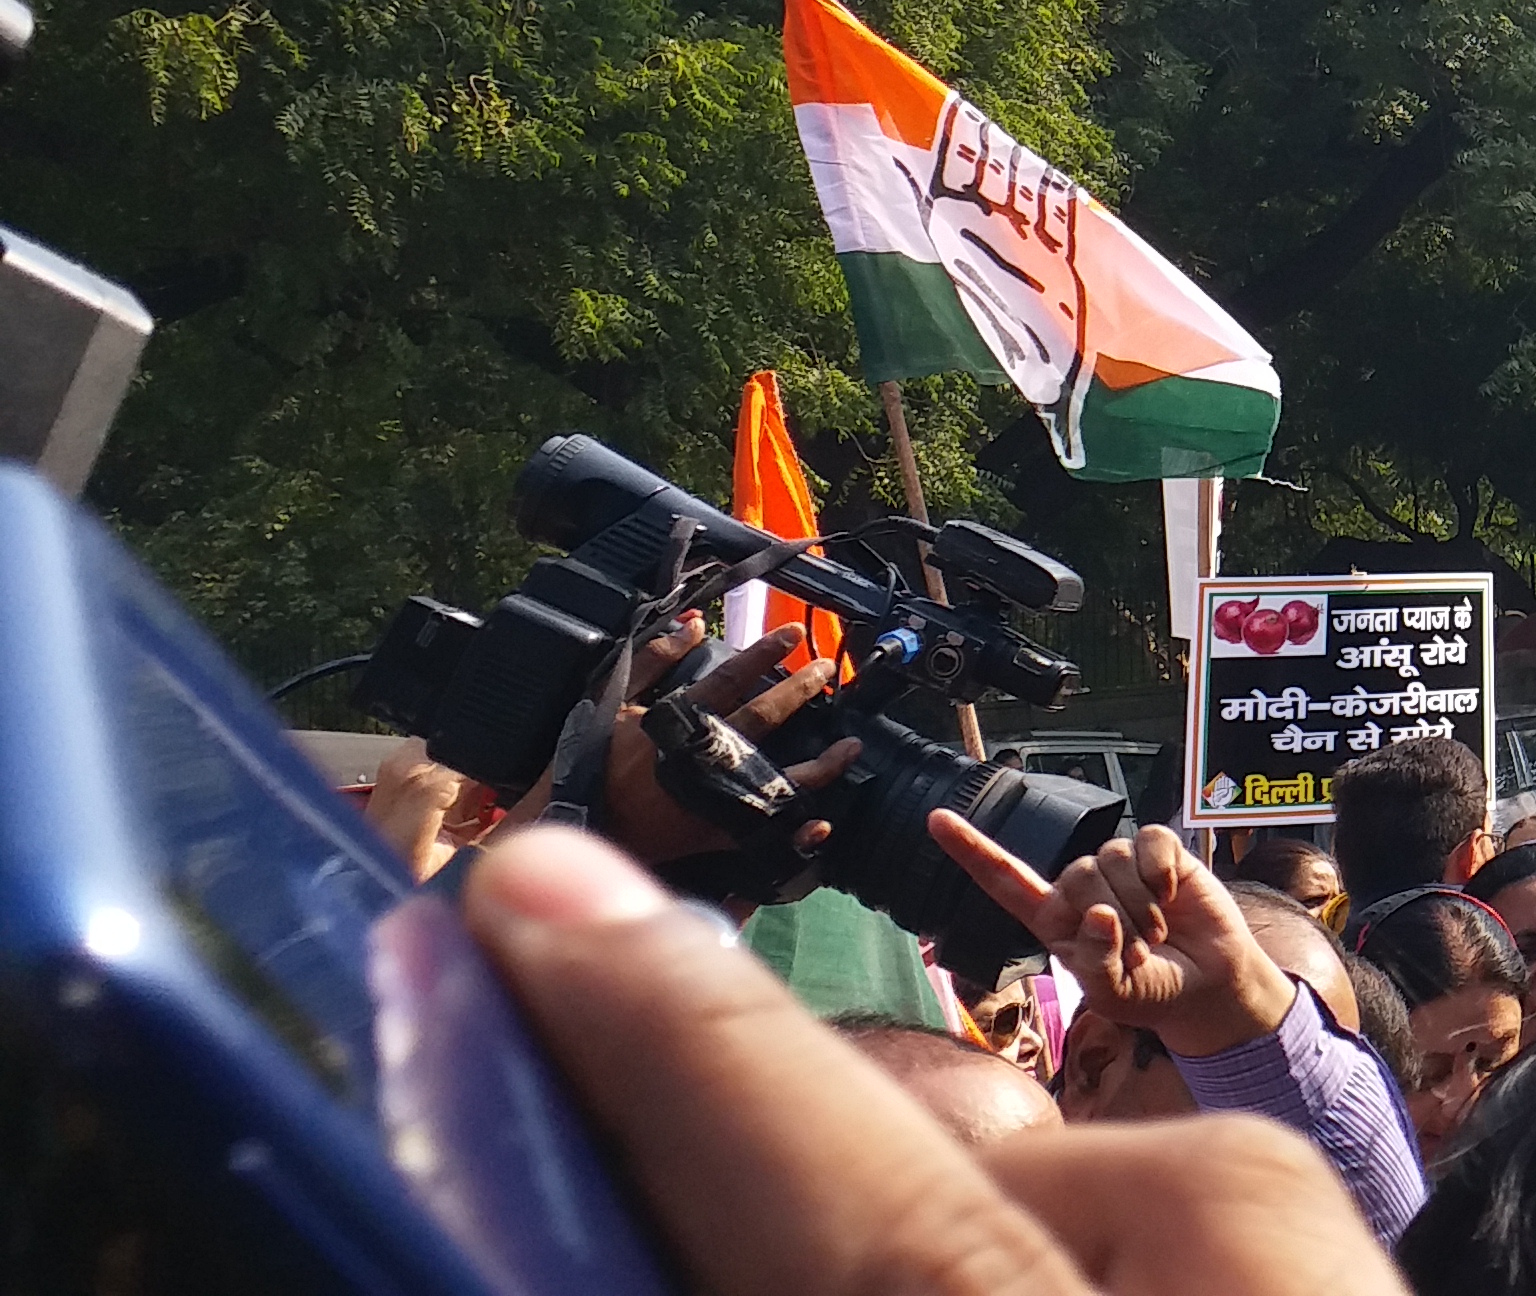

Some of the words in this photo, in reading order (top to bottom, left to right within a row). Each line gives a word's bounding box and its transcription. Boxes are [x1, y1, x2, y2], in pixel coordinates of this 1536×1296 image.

[1331, 606, 1399, 633] जनता
[1402, 605, 1451, 631] प्याज
[1453, 596, 1473, 629] के
[1335, 637, 1419, 678] आंसू
[1419, 634, 1468, 665] रोये
[1220, 681, 1480, 721] मोदी-केजरीवाल
[1270, 723, 1338, 753] चैन
[1346, 721, 1384, 750] से
[1244, 772, 1315, 805] दिल्ली
